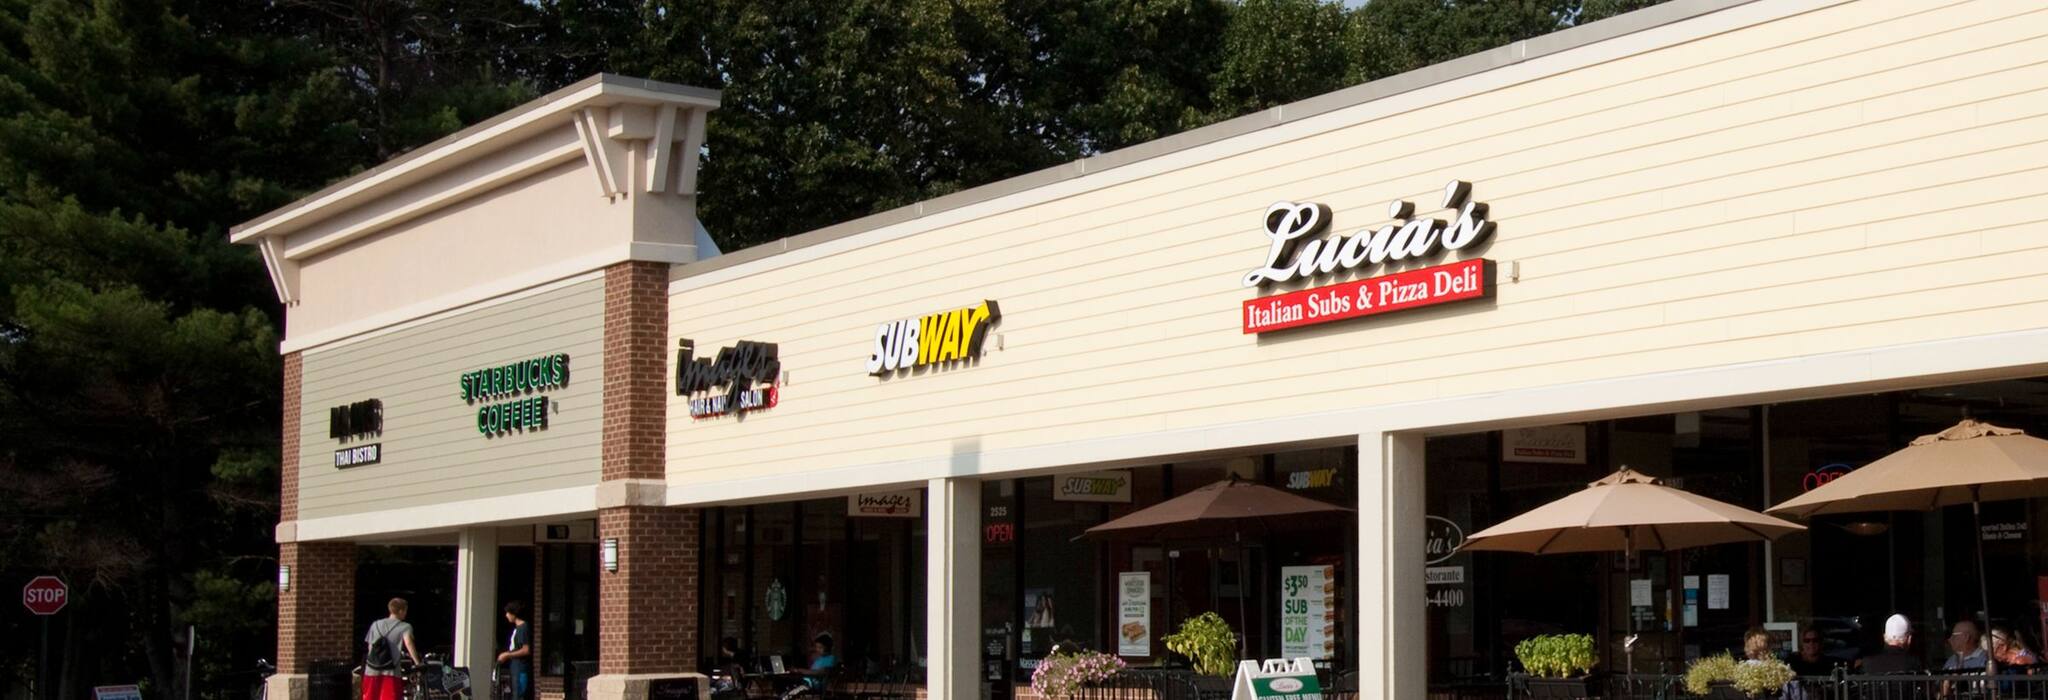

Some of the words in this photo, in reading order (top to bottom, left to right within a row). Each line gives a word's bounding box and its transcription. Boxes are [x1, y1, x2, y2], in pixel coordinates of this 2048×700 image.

[1242, 180, 1485, 288] Lucia's
[1247, 300, 1303, 329] Italian
[1308, 293, 1350, 319] Subs
[1356, 285, 1372, 310] &
[1378, 276, 1428, 307] Pizza
[1434, 265, 1478, 298] Deli
[864, 301, 994, 375] SUBWAY
[460, 353, 564, 401] STARBUCKS
[740, 389, 764, 409] SALON
[478, 396, 543, 435] COFFEE
[335, 449, 352, 467] THAI
[352, 444, 378, 465] BISTRO
[1062, 474, 1127, 496] SUBWAY
[1286, 468, 1337, 490] SUBWAY
[986, 523, 1014, 544] OPEN
[27, 588, 65, 603] STOP
[1285, 599, 1308, 614] SUB
[1285, 627, 1307, 642] DAY
